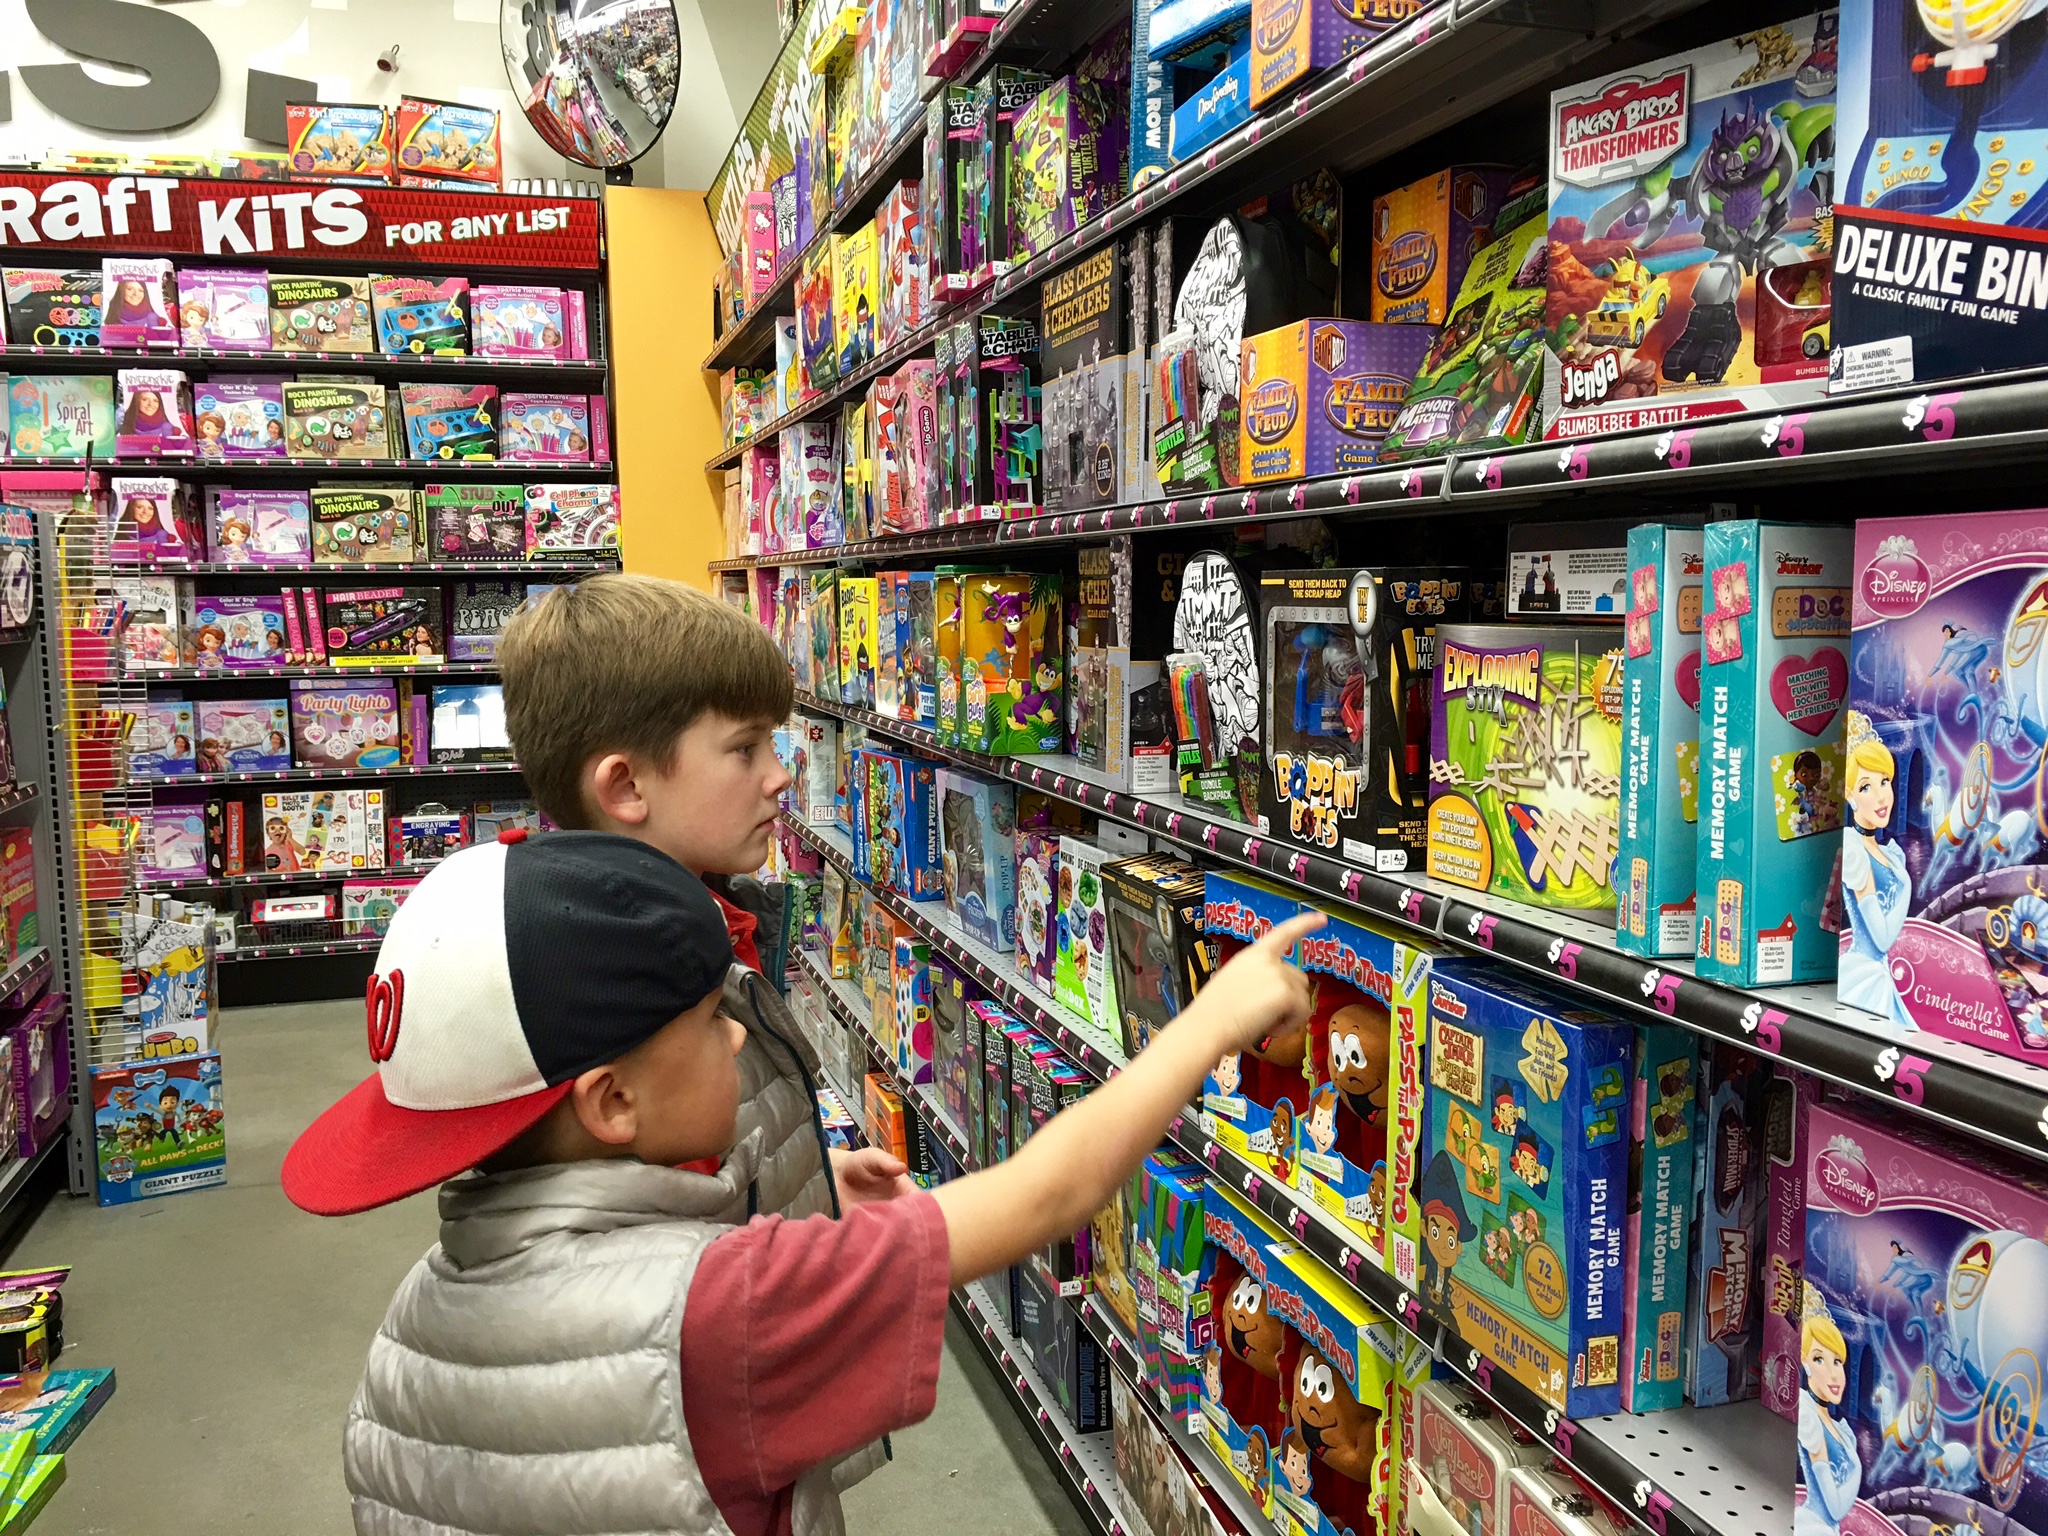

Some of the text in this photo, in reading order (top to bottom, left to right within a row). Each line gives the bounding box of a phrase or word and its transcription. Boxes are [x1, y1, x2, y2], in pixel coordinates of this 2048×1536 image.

[1407, 8, 1435, 44] $5
[1565, 90, 1679, 148] ANGRY BIRDS
[1080, 134, 1093, 175] TURTLES
[1563, 121, 1679, 173] TRANSFORMERS
[1882, 163, 1931, 191] BINGO
[199, 187, 368, 256] KiTS
[385, 221, 443, 247] FOR
[451, 212, 510, 240] aNY
[516, 207, 570, 233] LiST
[1380, 234, 1434, 269] FAMILY
[1043, 247, 1113, 309] GLASS CHESS
[1388, 262, 1425, 294] FEUD
[1835, 224, 2048, 311] DELUXE BIN
[277, 287, 338, 301] DINOSAURS
[291, 281, 322, 289] PAINTING
[374, 277, 436, 294] SPIRAL
[402, 290, 437, 302] ART
[1044, 281, 1110, 339] & CHECKERS
[1852, 282, 2018, 325] A CLASSIC FAMILY FUN GAME
[1862, 348, 1893, 360] WARNING:
[1564, 353, 1619, 403] Jenga
[57, 402, 91, 423] Spiral
[1249, 384, 1297, 417] FAMILY
[76, 419, 93, 436] Art
[1253, 409, 1289, 438] FEUD
[1559, 407, 1689, 437] BUMBLEBEE BATTLE
[1902, 392, 1964, 443] $5
[1156, 428, 1186, 456] TURTLES
[1655, 429, 1698, 469] $5
[1761, 413, 1812, 457] $5
[1183, 451, 1203, 470] DOODLE
[1184, 460, 1211, 482] BACKPACK
[1255, 455, 1287, 468] Game Cards
[1343, 453, 1373, 463] Game
[550, 489, 598, 500] Cell Phone
[1400, 468, 1425, 498] $5
[320, 500, 380, 514] DINOSAURS
[333, 494, 364, 503] PAINTING
[461, 487, 517, 514] STUD OUT
[556, 499, 591, 508] Charms
[333, 589, 400, 602] HAIR BEADER
[841, 586, 856, 609] BASKET
[1289, 579, 1346, 589] SEND THEM BACK TO
[1293, 588, 1341, 599] THE SCRAP HEAP
[1357, 588, 1369, 603] TRY
[1875, 595, 1918, 604] PRINCESS
[844, 609, 855, 628] CASE
[1358, 606, 1367, 623] ME
[468, 642, 489, 654] Tote
[1444, 643, 1539, 701] EXPLODING
[1788, 667, 1828, 685] MATCHING
[1792, 679, 1829, 696] FUN WITH
[1795, 691, 1828, 707] DOC AND
[302, 694, 389, 713] Party Lights
[1466, 685, 1507, 726] STIX
[1787, 699, 1839, 720] HER FRIENDS!
[1711, 686, 1727, 860] MEMORY MATCH
[1729, 746, 1741, 801] GAME
[411, 821, 450, 829] ENGRAVING
[1291, 800, 1338, 848] BOTS
[1437, 809, 1478, 826] CREATE YOUR OWN
[1440, 823, 1474, 836] STIX EXPLOSION
[1432, 832, 1482, 850] USING KINETIC ENERGY!
[1433, 850, 1480, 869] EVERY ACTION HAS AN
[1435, 861, 1478, 880] AMAZING REACTION!
[1399, 888, 1424, 923] $5
[1302, 939, 1393, 1001] PASS THE POTATO
[1641, 968, 1683, 1015] $5
[1914, 982, 2003, 1026] Cinderella's
[1439, 1025, 1474, 1046] CAPTAIN
[1740, 1003, 1789, 1054] $5
[1946, 1012, 2009, 1042] Coach Game
[1445, 1042, 1474, 1067] JAKE
[1394, 1007, 1417, 1224] PASS THE POTATO
[140, 1139, 224, 1167] ALL PAWS DECK!
[1722, 1123, 1739, 1194] SPIDER-MAN
[144, 1168, 223, 1189] GIANT PUZZLE
[1792, 1178, 1801, 1210] Game
[1670, 1204, 1683, 1250] GAME
[1777, 1177, 1792, 1249] Tangled
[1652, 1156, 1671, 1301] MEMORY MATCH
[1587, 1178, 1607, 1321] MEMORY MATCH
[1607, 1227, 1621, 1268] GAME
[1339, 1247, 1361, 1285] $5
[1538, 1258, 1551, 1280] 72
[1527, 1272, 1562, 1300] Memory Match
[1536, 1288, 1552, 1304] Cards!
[1769, 1254, 1789, 1317] POP-UP
[1268, 1284, 1355, 1385] PASS THE POTATO
[1467, 1301, 1549, 1374] MEMORY MATCH
[1495, 1344, 1517, 1370] GAME
[1544, 1410, 1578, 1458] $5
[1430, 1421, 1485, 1494] Storybook
